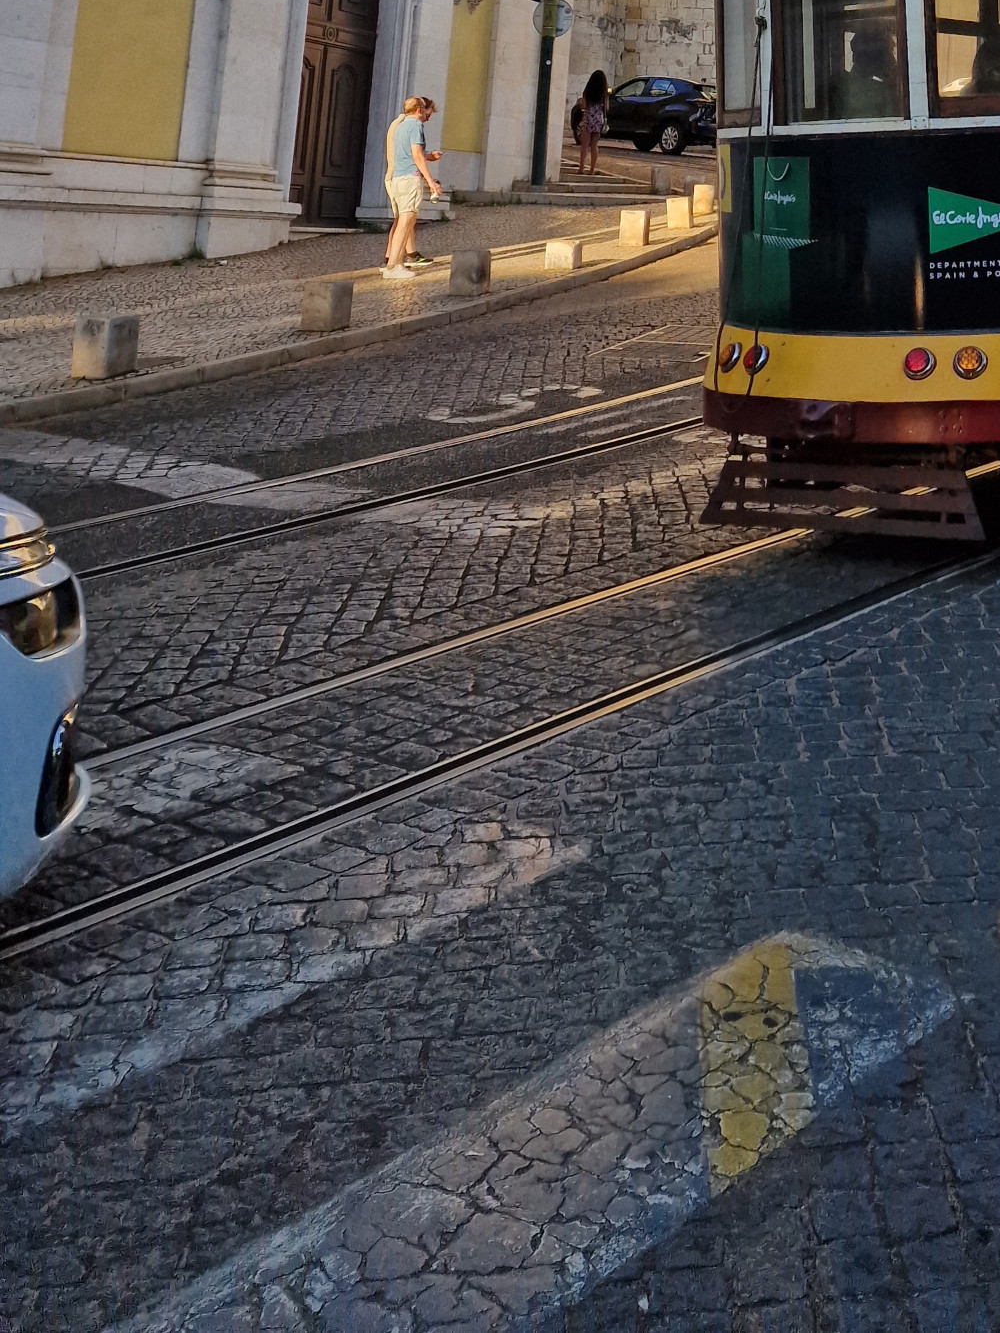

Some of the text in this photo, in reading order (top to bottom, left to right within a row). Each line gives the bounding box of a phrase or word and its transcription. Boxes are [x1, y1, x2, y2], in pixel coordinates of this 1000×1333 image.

[932, 210, 946, 225] El
[946, 210, 976, 225] Corte
[929, 270, 966, 280] SPAIN
[972, 270, 979, 279] &
